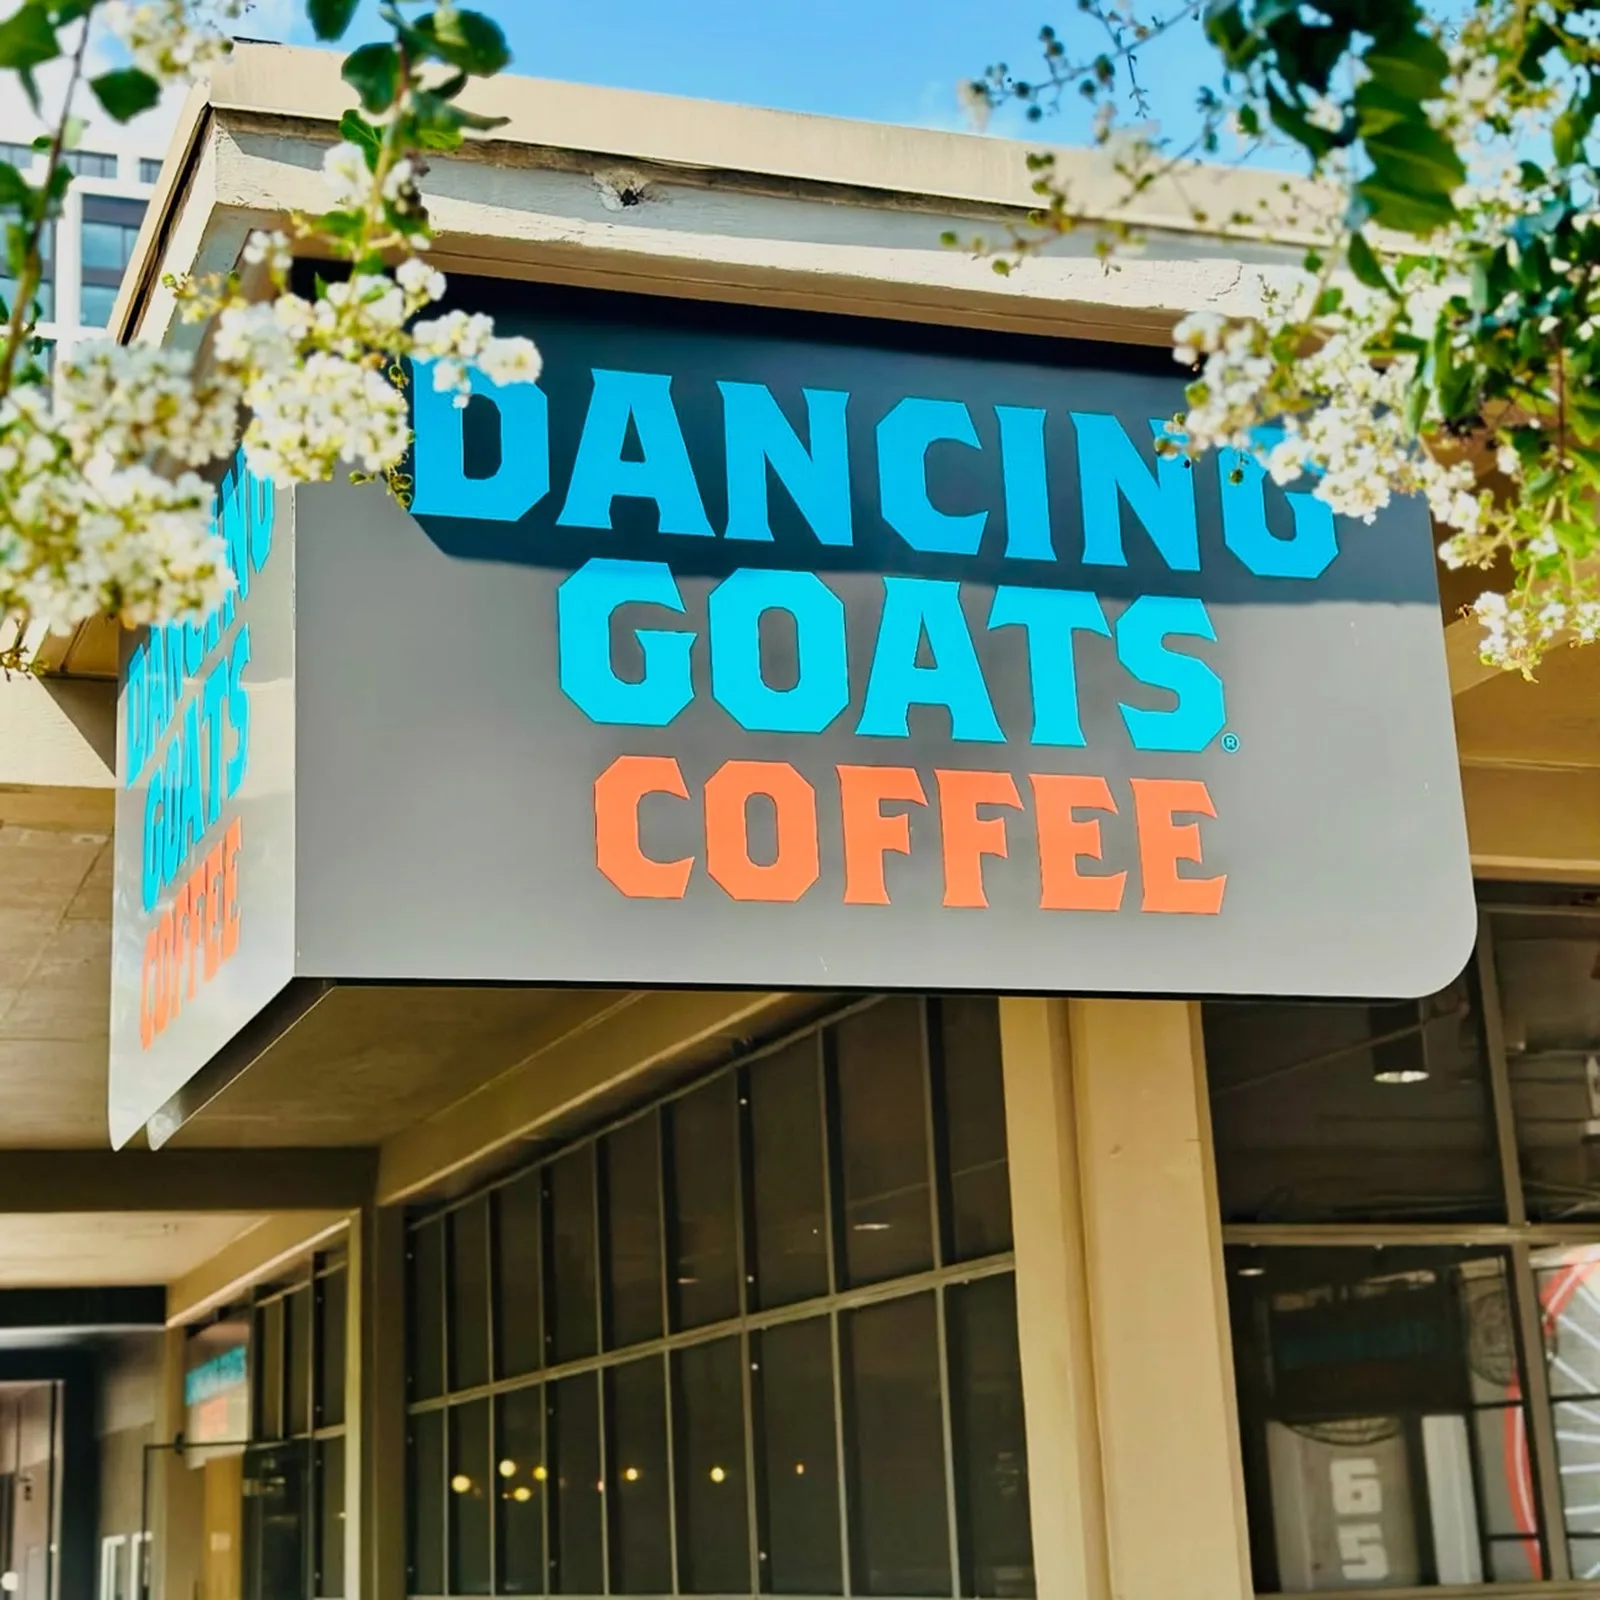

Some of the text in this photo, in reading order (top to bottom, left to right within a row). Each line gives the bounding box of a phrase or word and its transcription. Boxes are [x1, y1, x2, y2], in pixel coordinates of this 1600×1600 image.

[408, 357, 1340, 579] DANCING
[141, 621, 251, 913] GOATS
[593, 754, 1227, 916] COFFEE
[140, 816, 243, 1052] COFFEE
